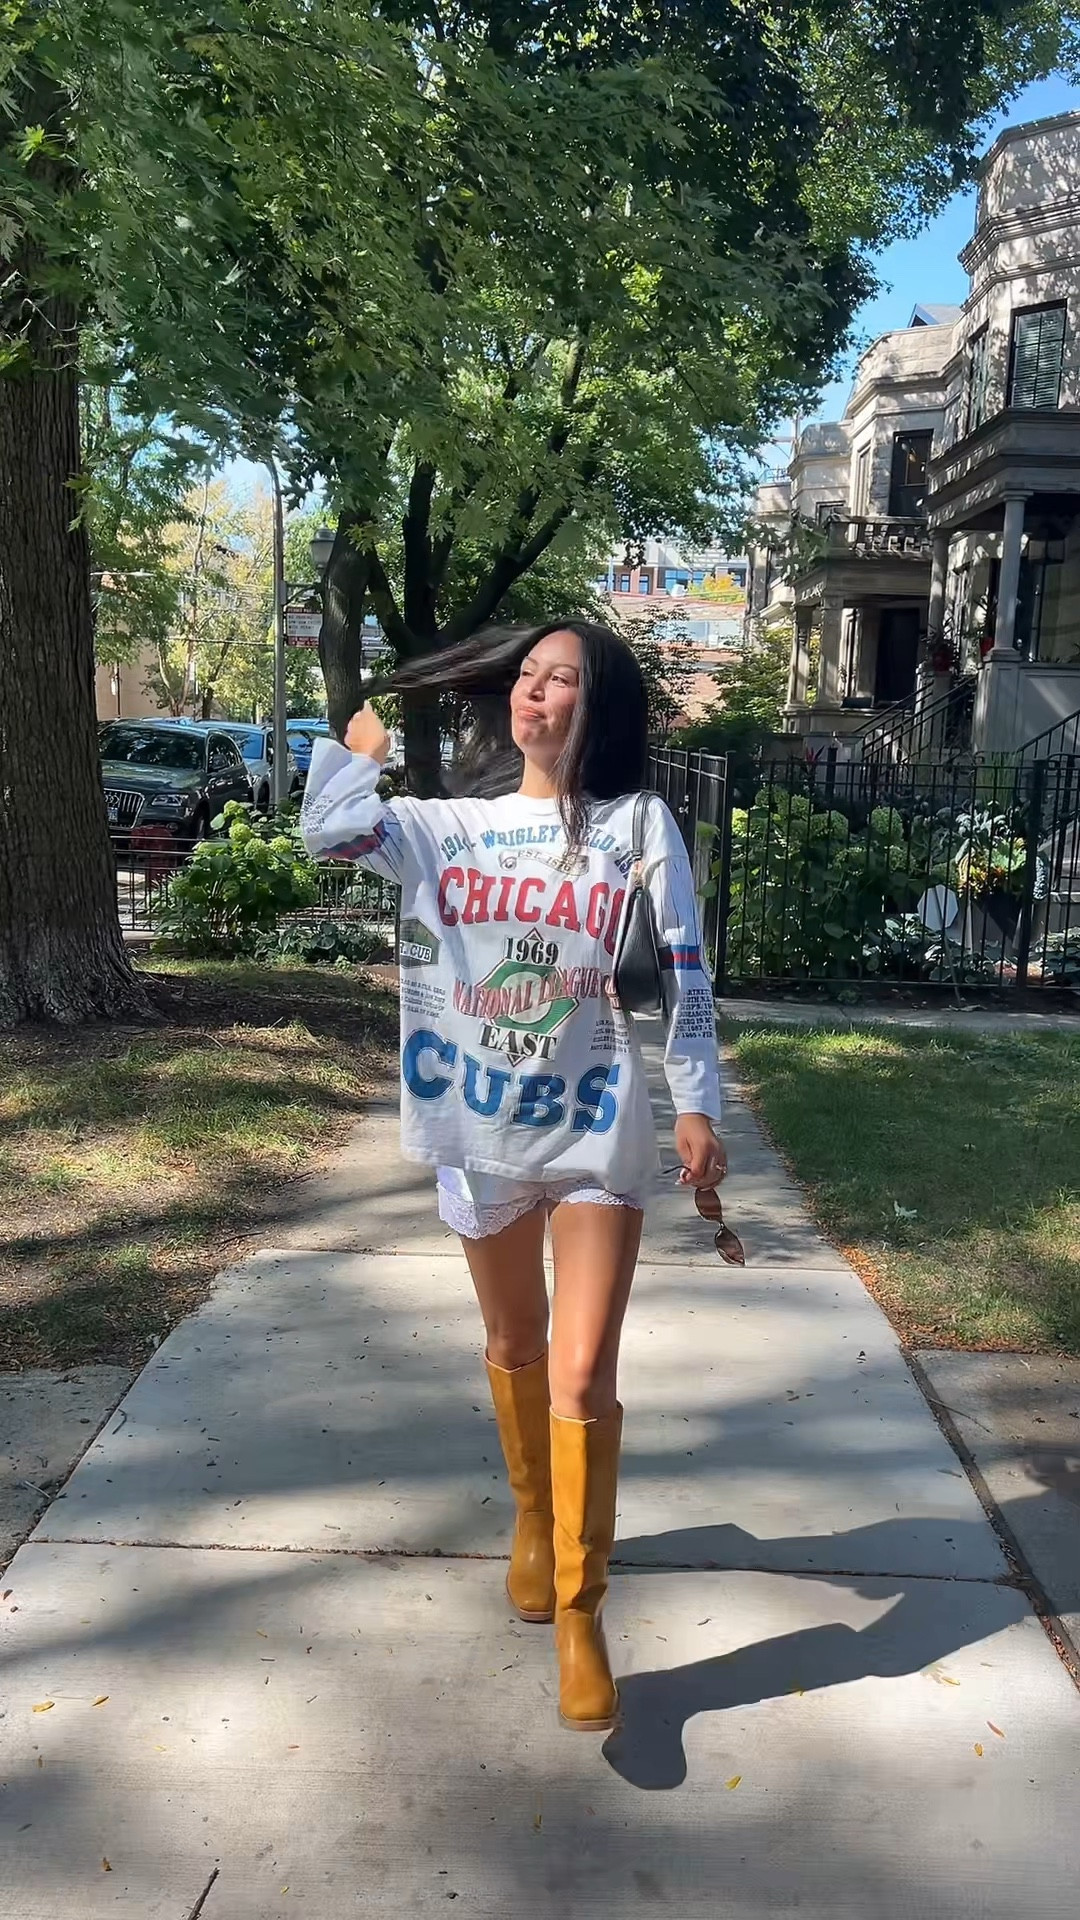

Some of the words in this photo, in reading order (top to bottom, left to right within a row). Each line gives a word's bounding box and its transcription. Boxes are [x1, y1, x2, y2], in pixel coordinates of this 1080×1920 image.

[480, 824, 560, 849] WRIGLEY
[410, 944, 431, 961] CUB
[506, 937, 559, 965] 1969
[453, 977, 532, 1019] NATIONAL
[538, 966, 599, 1006] LEAGUE
[479, 1023, 557, 1059] EAST
[402, 1027, 619, 1135] CUBS
